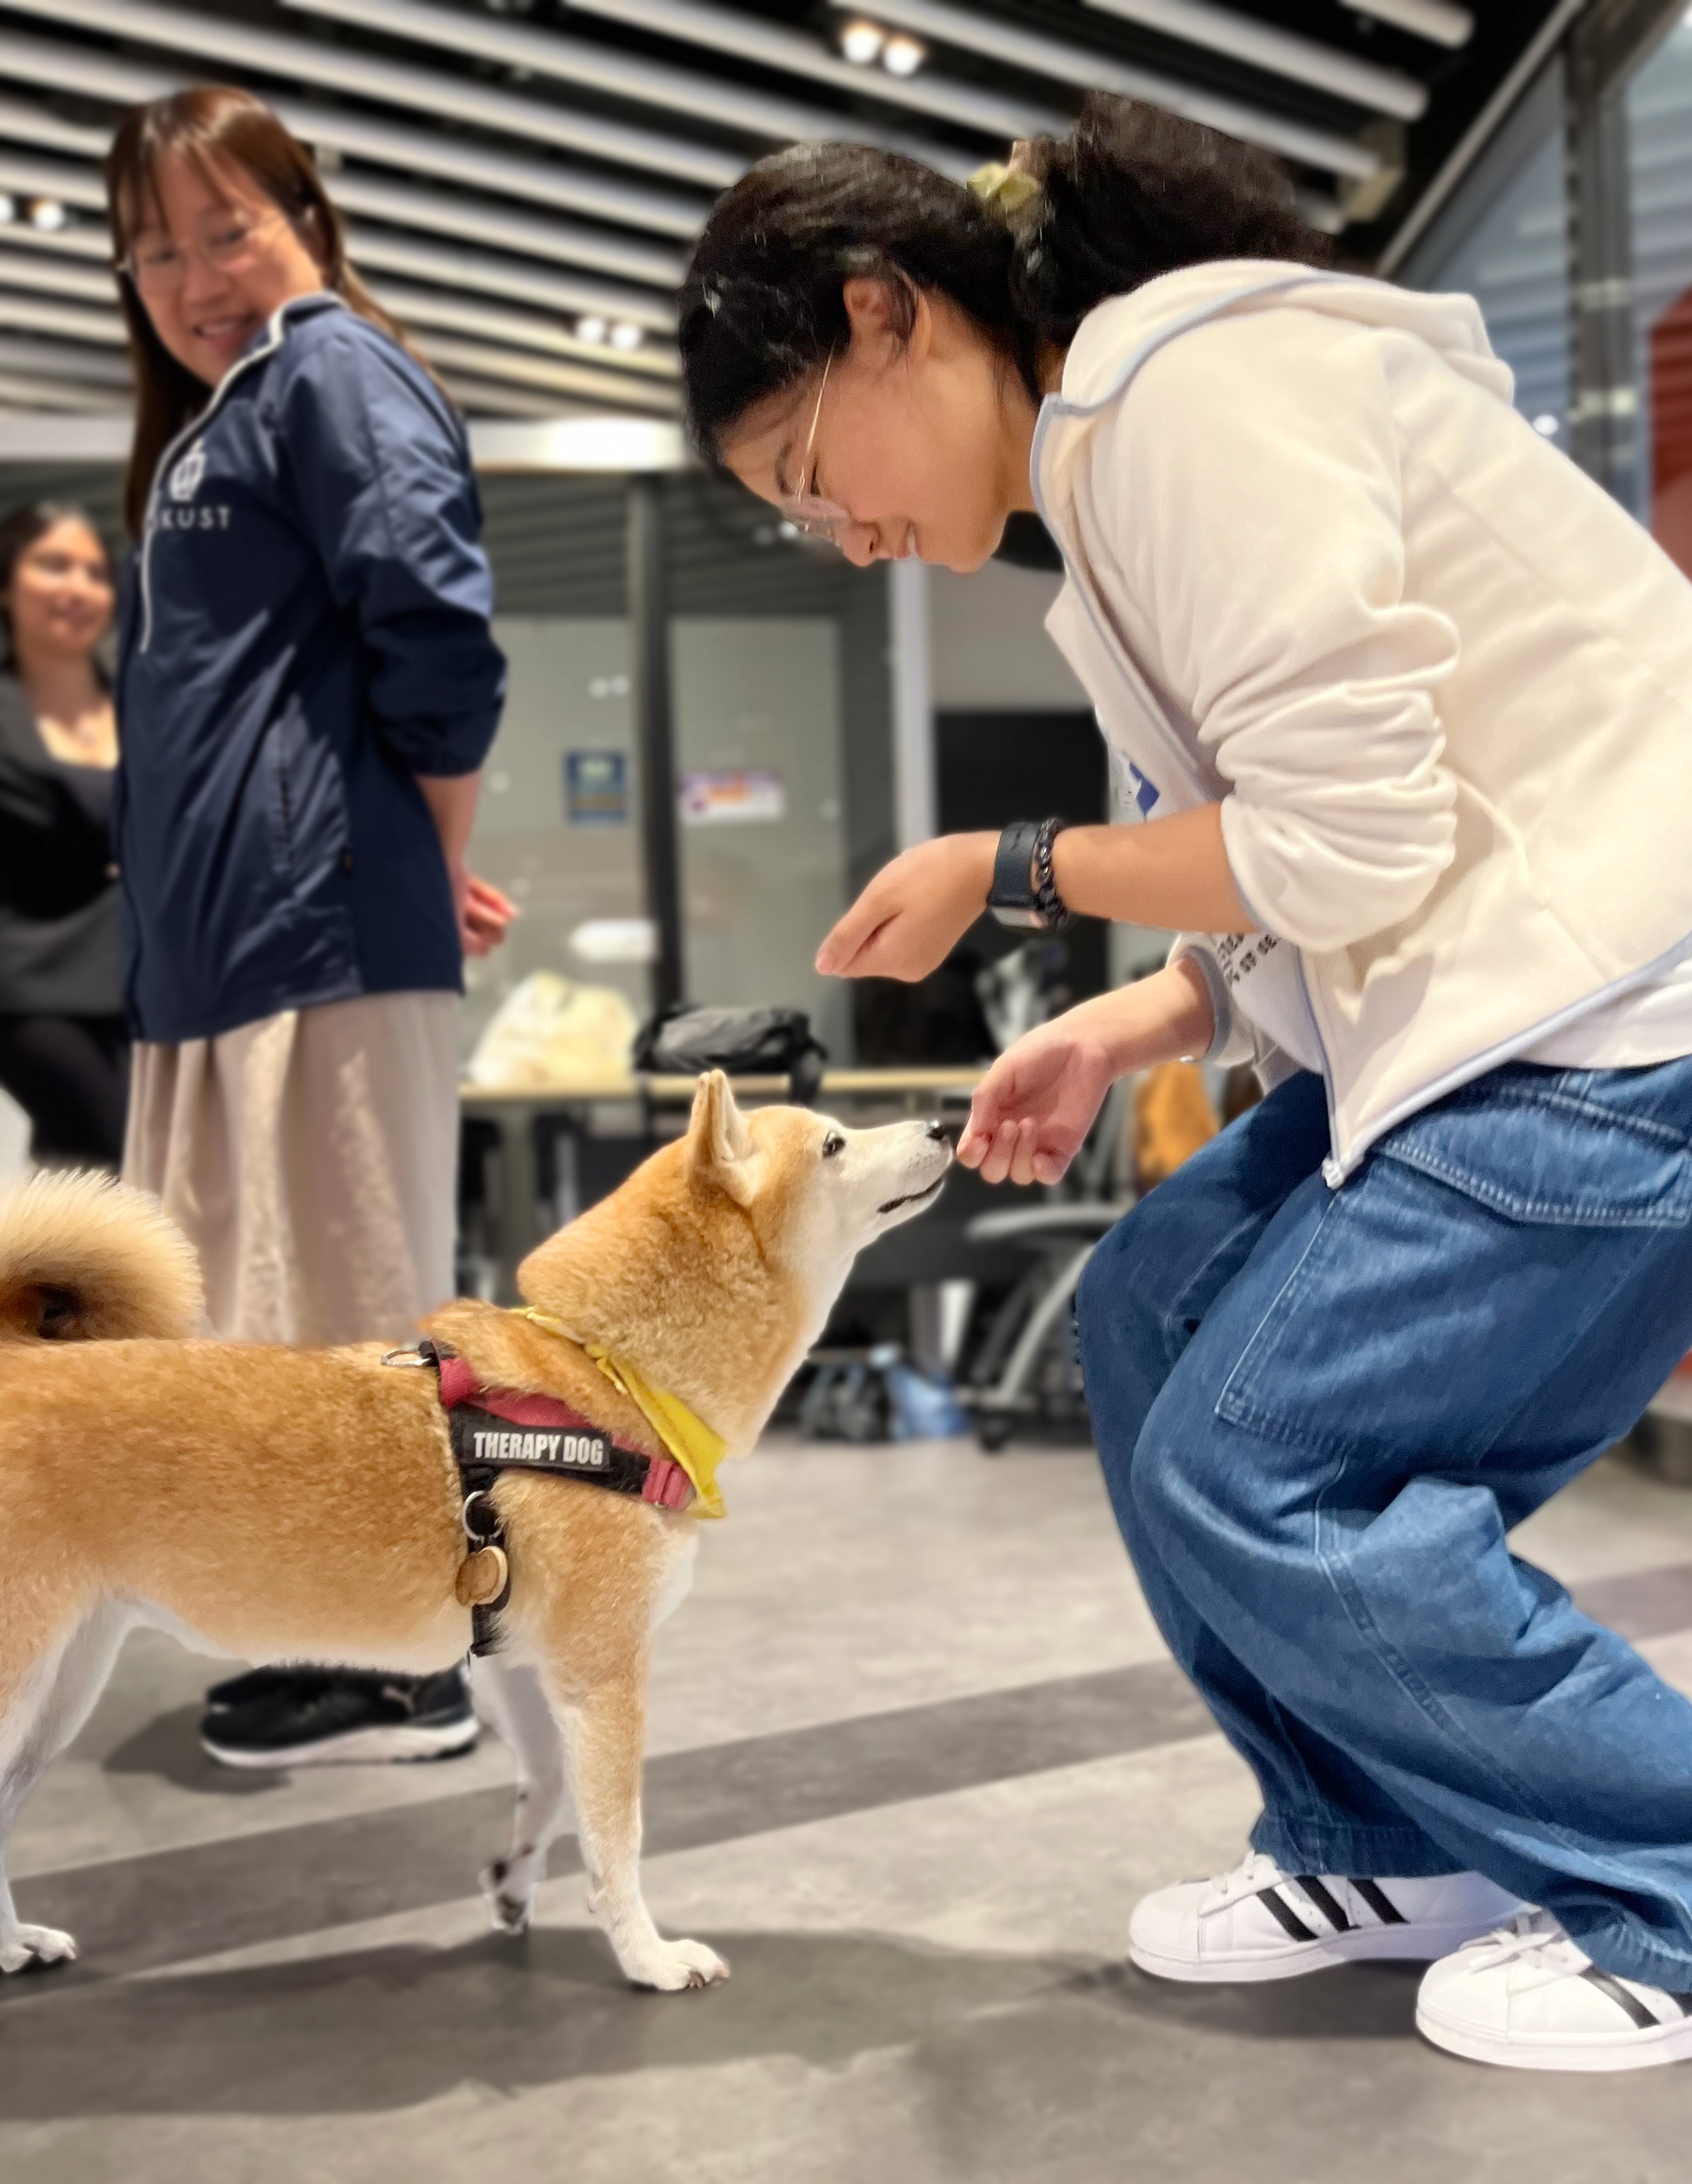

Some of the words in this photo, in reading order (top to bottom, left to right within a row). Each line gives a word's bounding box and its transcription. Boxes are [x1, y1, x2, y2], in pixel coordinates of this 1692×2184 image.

[156, 506, 230, 529] KUST
[473, 1433, 561, 1461] THERAPY
[563, 1436, 604, 1465] DOG
